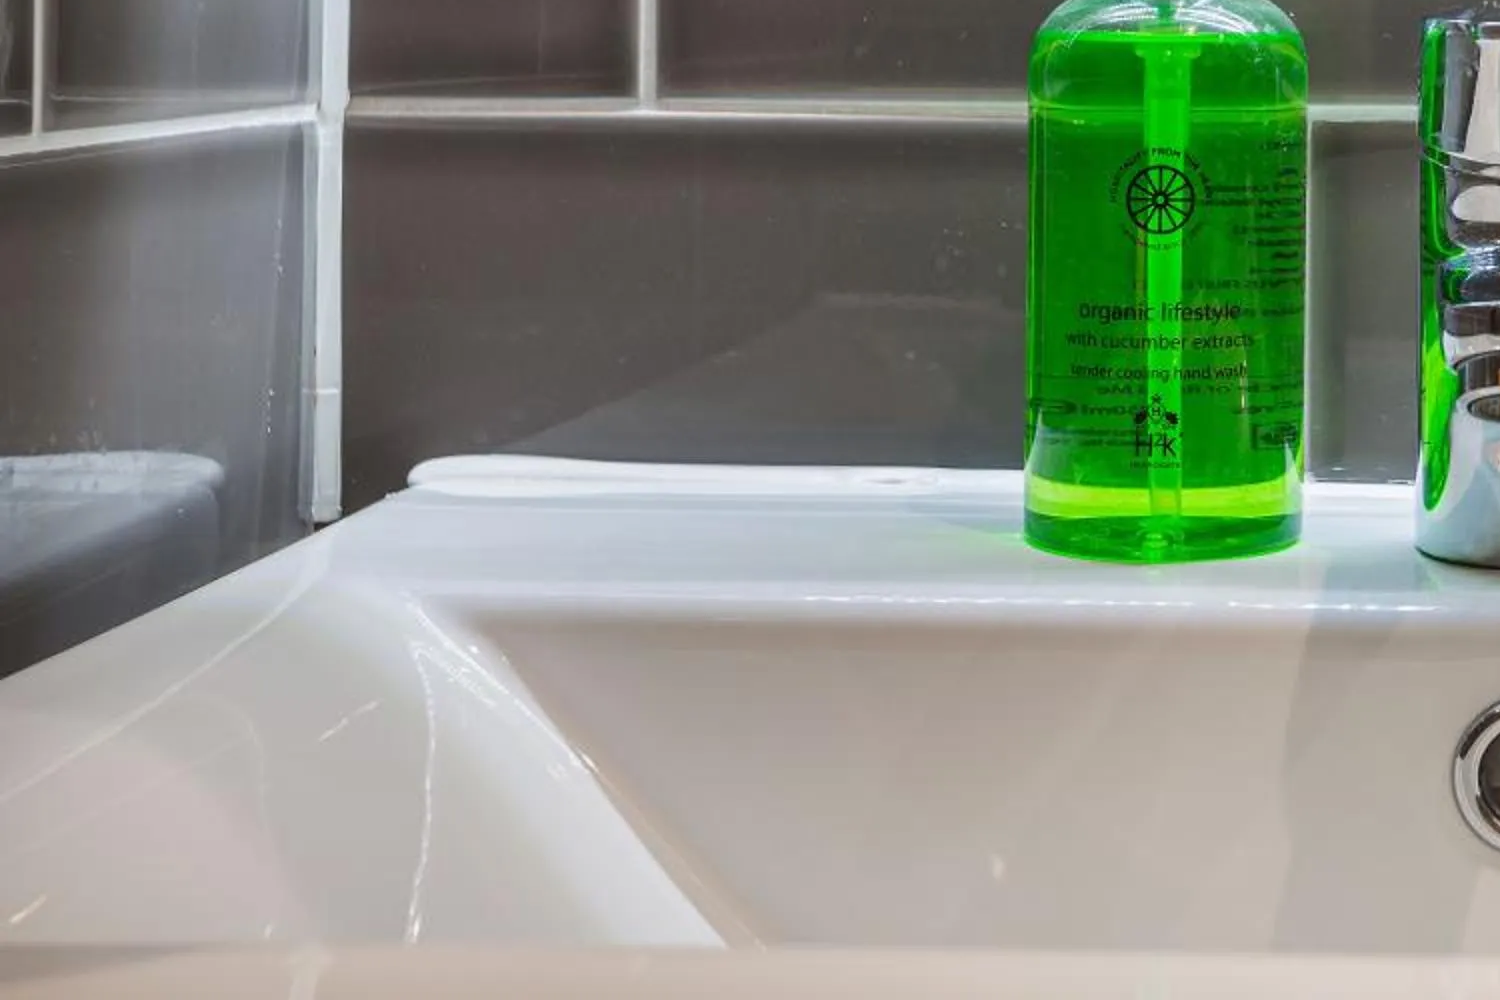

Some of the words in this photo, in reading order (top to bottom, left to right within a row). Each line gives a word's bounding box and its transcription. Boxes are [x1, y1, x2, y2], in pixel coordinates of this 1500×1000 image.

[1079, 302, 1154, 325] organic
[1160, 300, 1241, 326] lifestyle
[1065, 331, 1097, 347] with
[1100, 333, 1187, 350] cucumber
[1193, 334, 1255, 350] extracts
[1116, 367, 1171, 384] coolng
[1174, 366, 1211, 381] hand
[1215, 361, 1247, 379] wash
